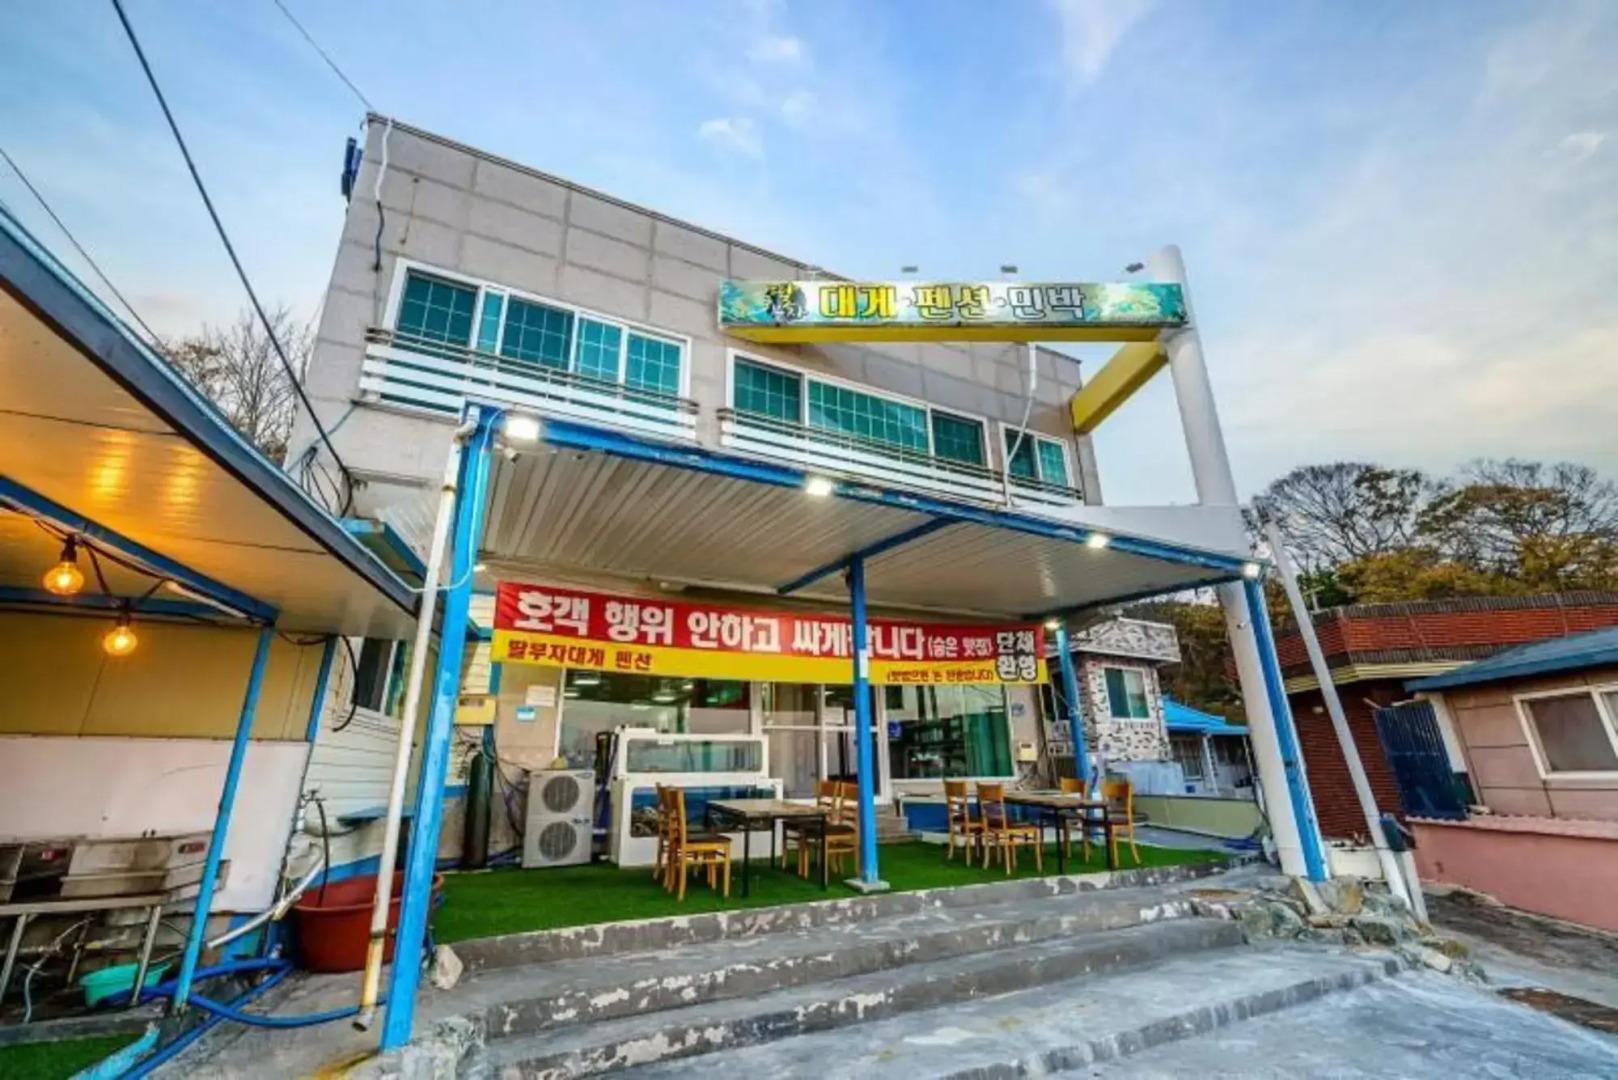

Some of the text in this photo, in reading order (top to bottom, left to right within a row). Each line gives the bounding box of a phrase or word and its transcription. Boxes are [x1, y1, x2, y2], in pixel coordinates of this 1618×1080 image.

[819, 285, 1086, 320] 대게 펜션 민박
[514, 591, 589, 636] 호객
[605, 601, 674, 645] 행위
[687, 611, 781, 652] 안하고
[996, 630, 1036, 653] 단체
[615, 650, 652, 671] 펜션
[997, 654, 1037, 681] 환영
